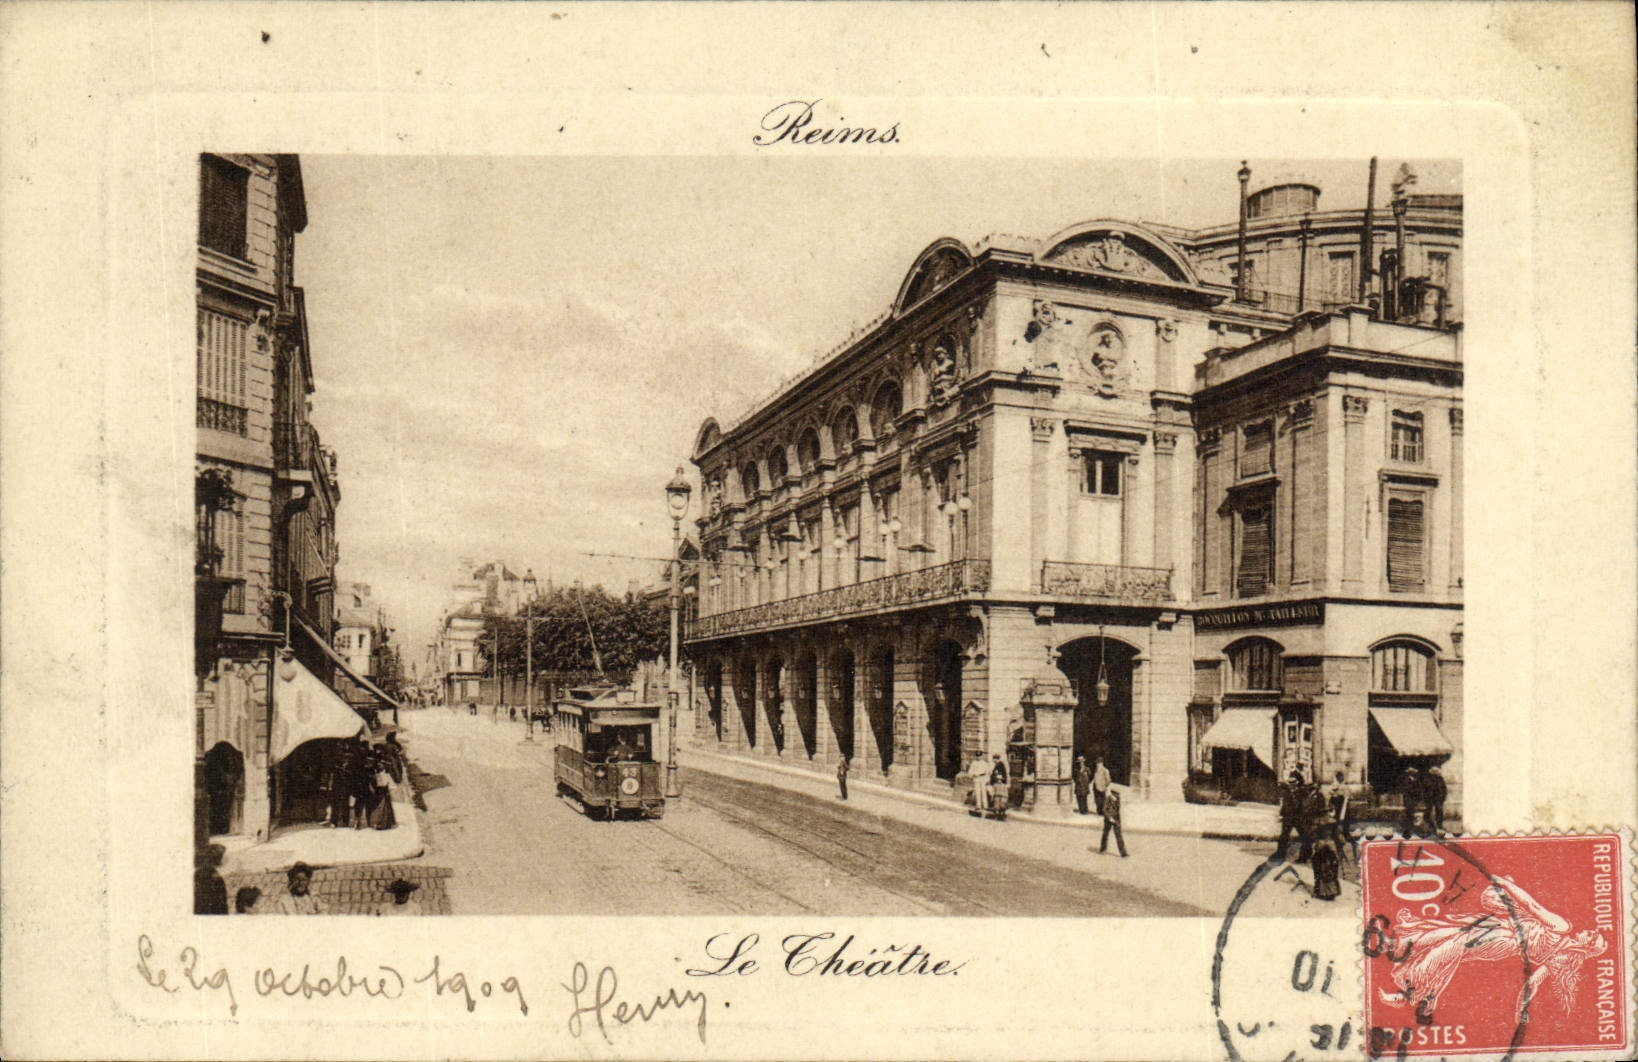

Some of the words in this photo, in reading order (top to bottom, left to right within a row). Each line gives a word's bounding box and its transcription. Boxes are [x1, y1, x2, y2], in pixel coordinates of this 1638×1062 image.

[1592, 843, 1614, 933] REPUBLIQUE
[136, 934, 179, 993] Le
[180, 946, 238, 1016] 29
[414, 956, 528, 1015] 1909
[1596, 958, 1618, 1043] FRANÇAISE
[1383, 1024, 1467, 1047] POSTES
